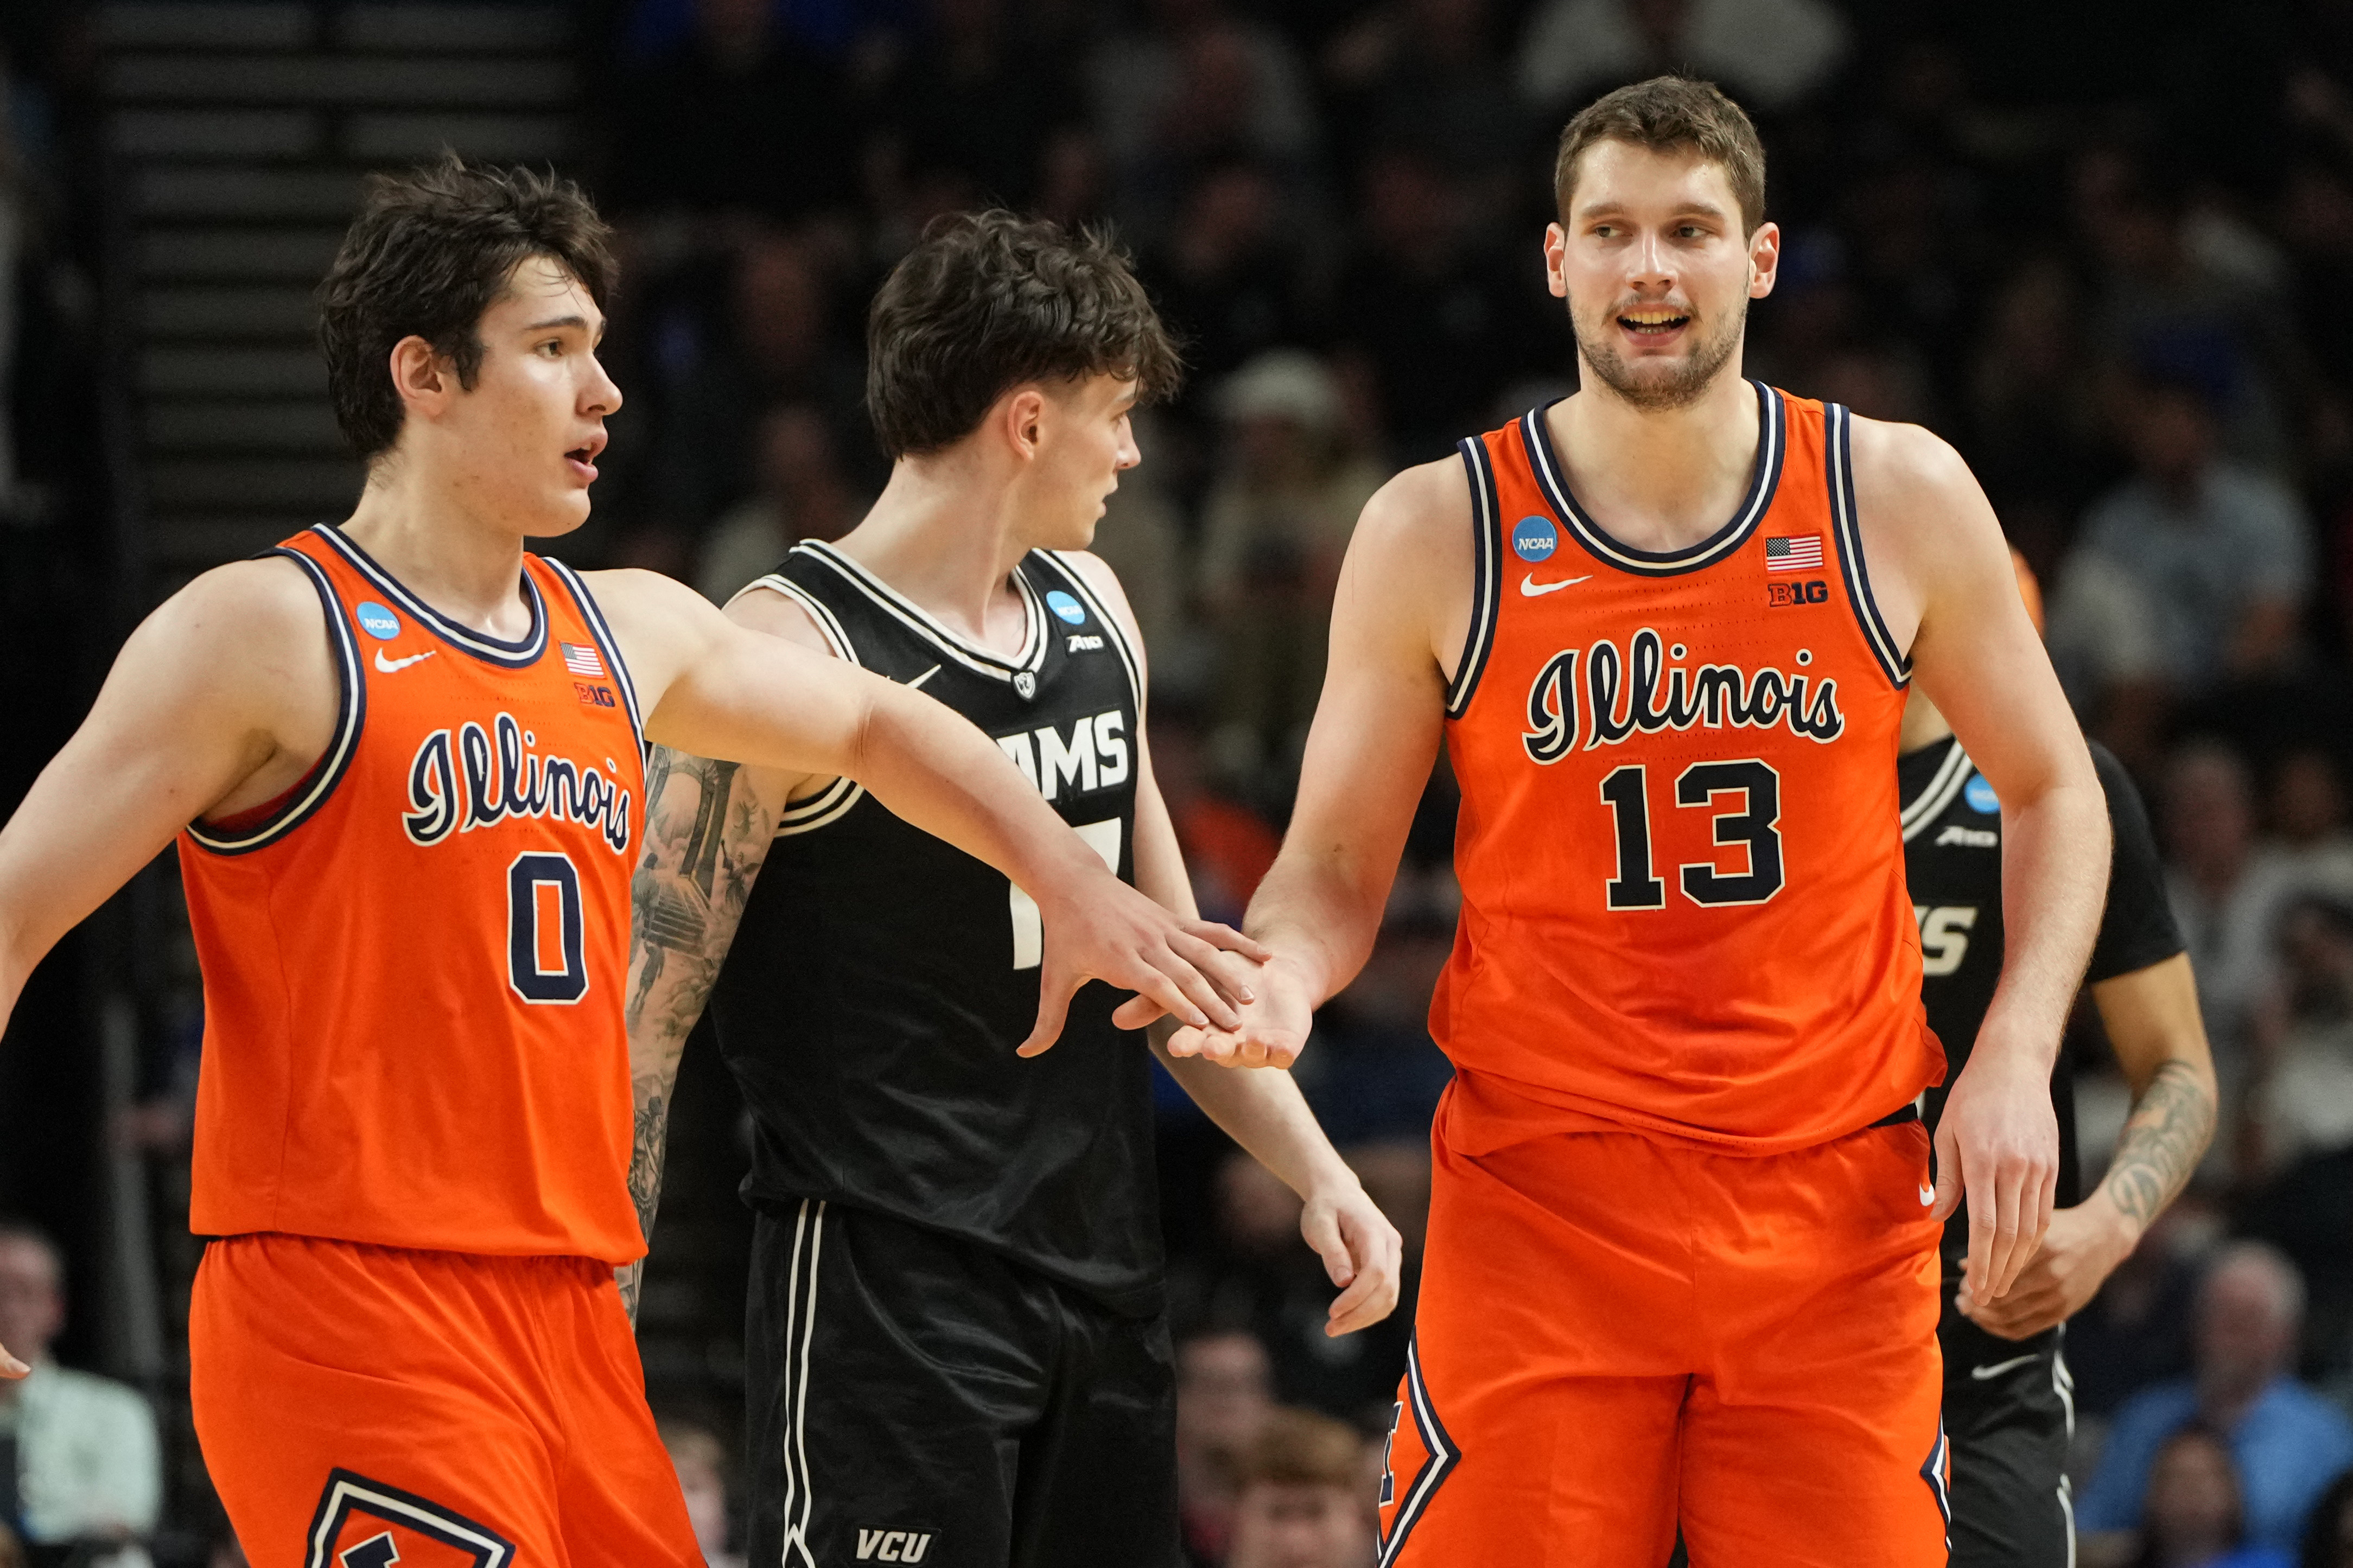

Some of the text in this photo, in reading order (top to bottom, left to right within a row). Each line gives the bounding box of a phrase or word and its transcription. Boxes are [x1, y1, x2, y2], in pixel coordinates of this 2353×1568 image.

[1518, 537, 1554, 551] NCAA
[364, 618, 399, 629] NCAA
[1522, 627, 1846, 766] Illinois
[402, 711, 631, 855] Illinois
[996, 710, 1128, 800] AMS
[1599, 757, 1785, 911] 13
[506, 851, 590, 1005] 0
[856, 1528, 931, 1563] VCU
